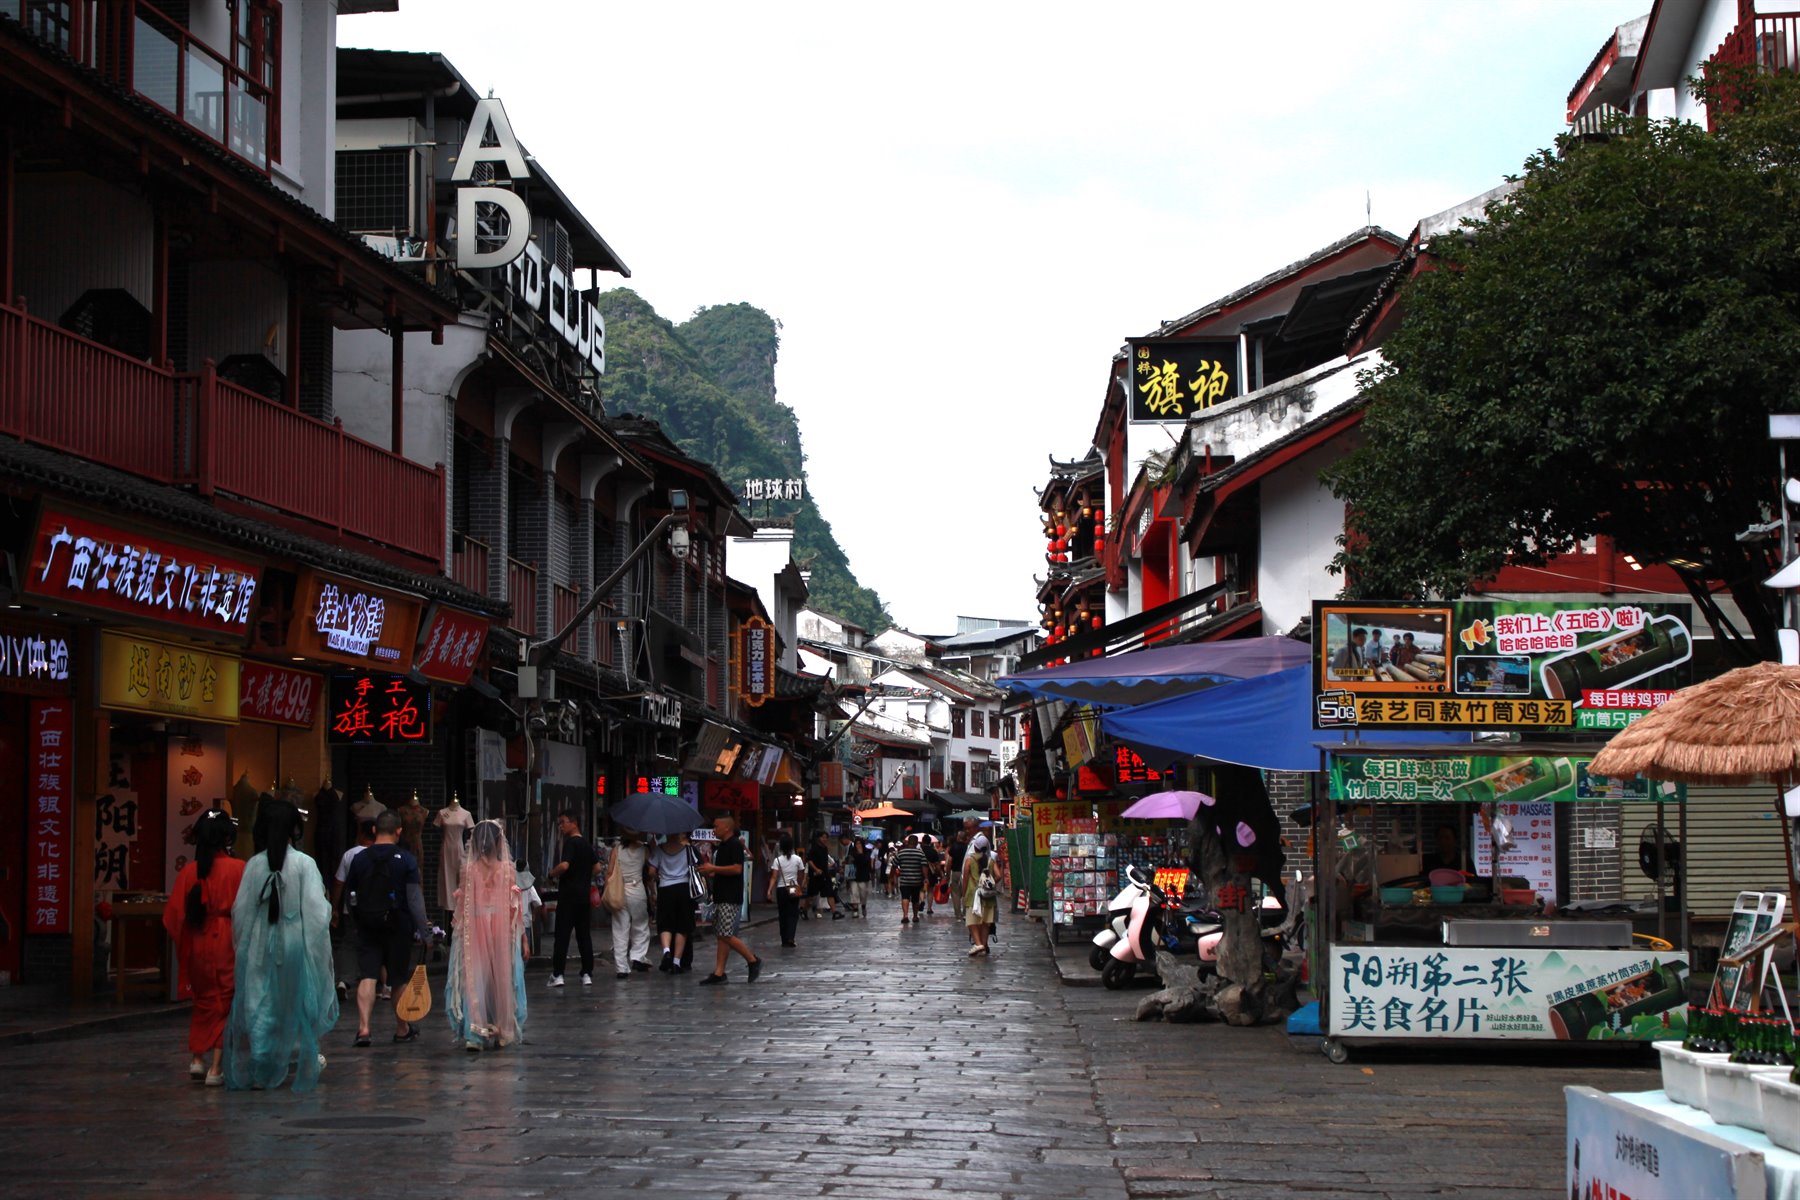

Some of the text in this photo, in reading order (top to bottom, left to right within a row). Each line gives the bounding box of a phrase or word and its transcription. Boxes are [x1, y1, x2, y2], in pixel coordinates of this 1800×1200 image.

[549, 264, 605, 375] CLUB
[1139, 359, 1229, 415] 旗袍
[745, 478, 803, 500] 地球村
[41, 525, 257, 625] 广西壮族银文化非遗馆
[1499, 634, 1574, 653] 哈哈哈哈哈
[354, 677, 408, 697] 手工
[1589, 692, 1674, 708] 每日鲜鸡现
[333, 697, 425, 740] 旗袍
[1361, 700, 1567, 723] 综艺同款竹筒鸡汤
[1364, 758, 1470, 779] 每日鲜鸡现做
[1346, 779, 1453, 799] 竹筒只用一次
[1520, 803, 1552, 816] MASSAGE
[1341, 952, 1533, 997] 阳朔第二张
[1341, 996, 1489, 1033] 美食名片
